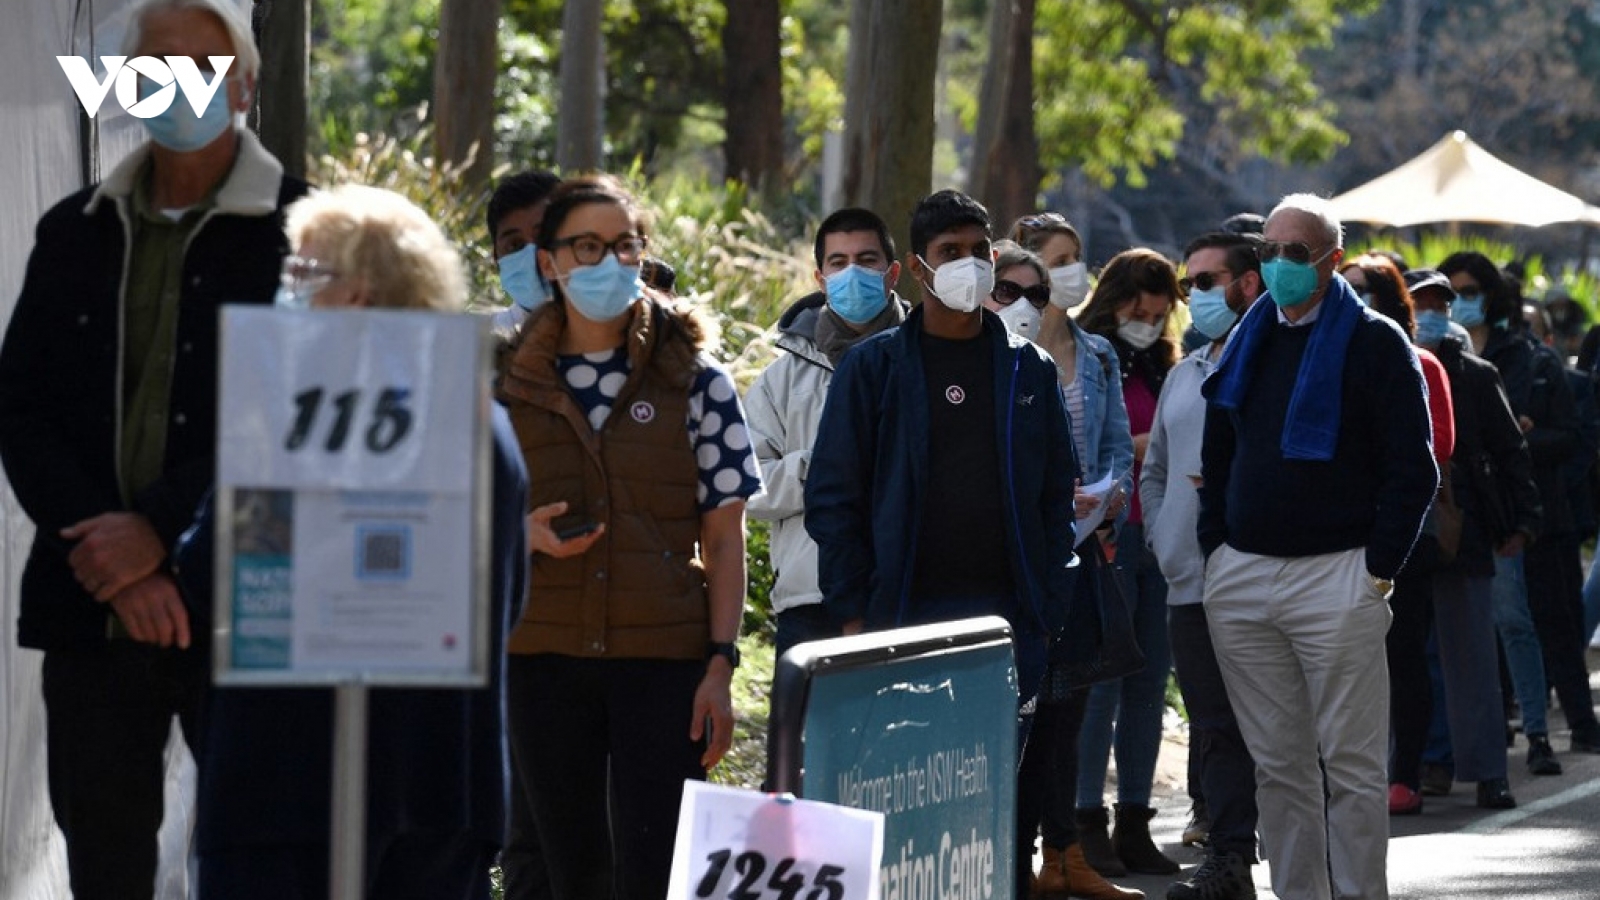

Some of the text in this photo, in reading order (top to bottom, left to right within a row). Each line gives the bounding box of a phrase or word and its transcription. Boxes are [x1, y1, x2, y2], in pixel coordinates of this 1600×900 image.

[285, 386, 413, 454] 115
[838, 742, 988, 815] Welcome to the NSW Health
[695, 848, 845, 900] 1245
[938, 828, 993, 900] Centre
